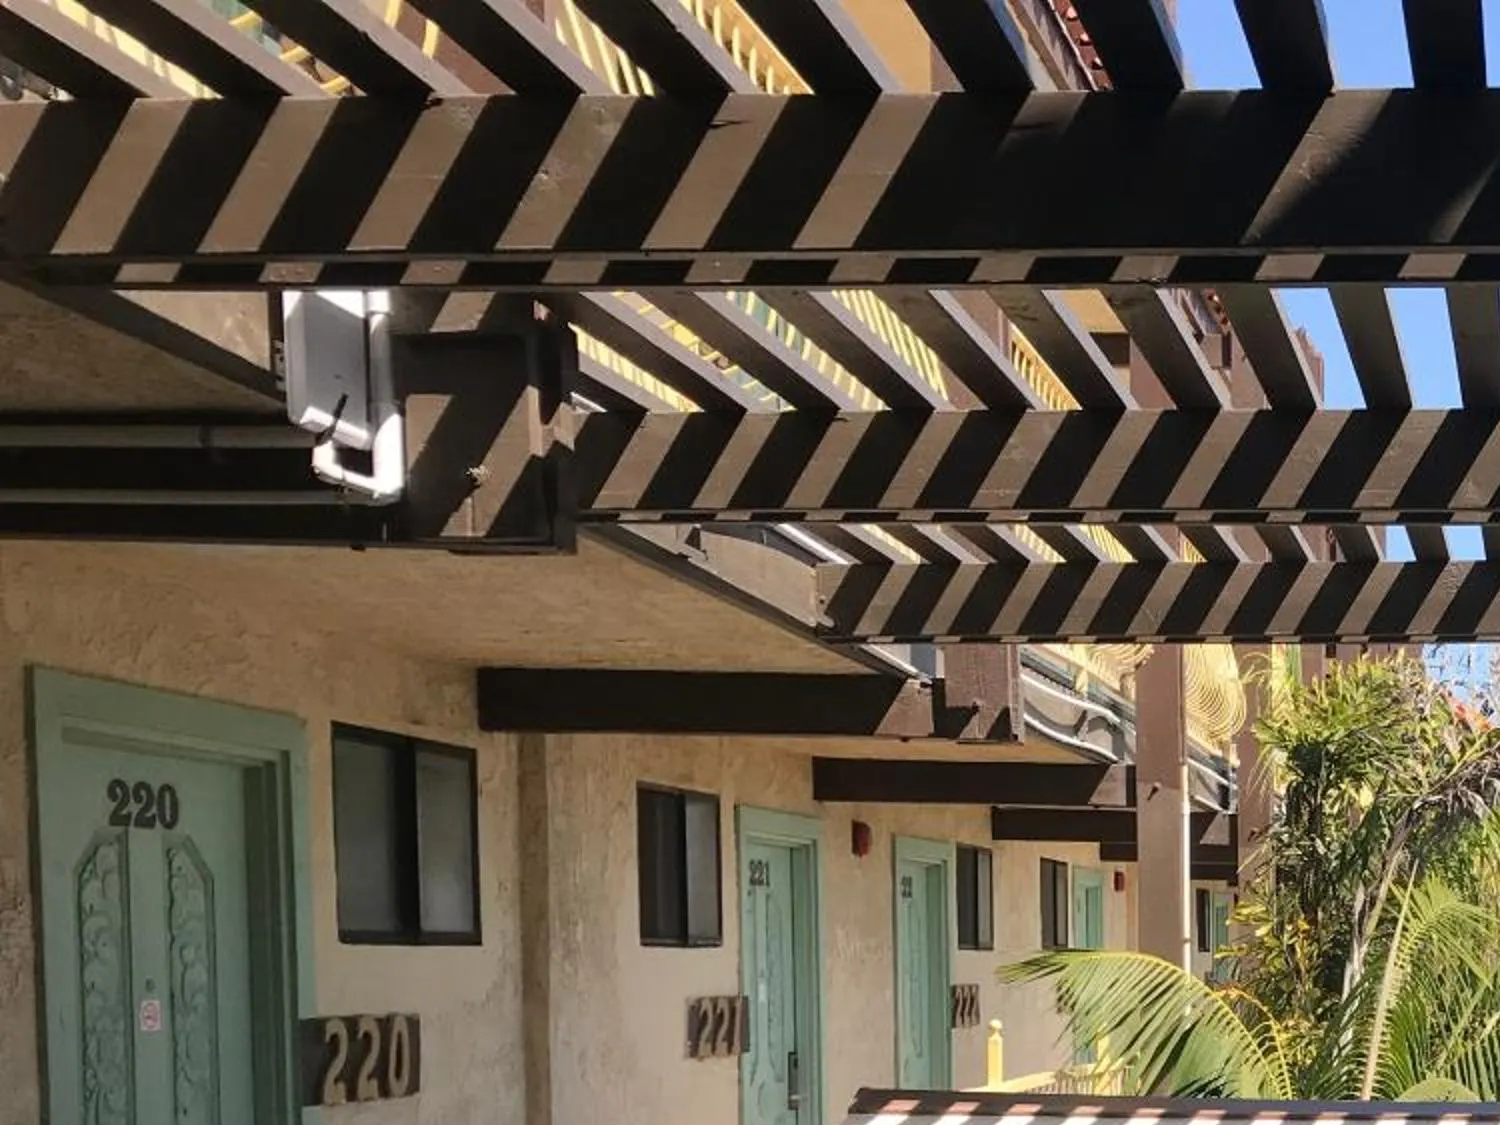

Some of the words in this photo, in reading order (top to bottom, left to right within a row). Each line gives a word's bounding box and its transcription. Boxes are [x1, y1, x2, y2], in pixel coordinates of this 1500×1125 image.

[106, 778, 179, 830] 220
[322, 1014, 411, 1105] 220
[699, 997, 743, 1060] 221
